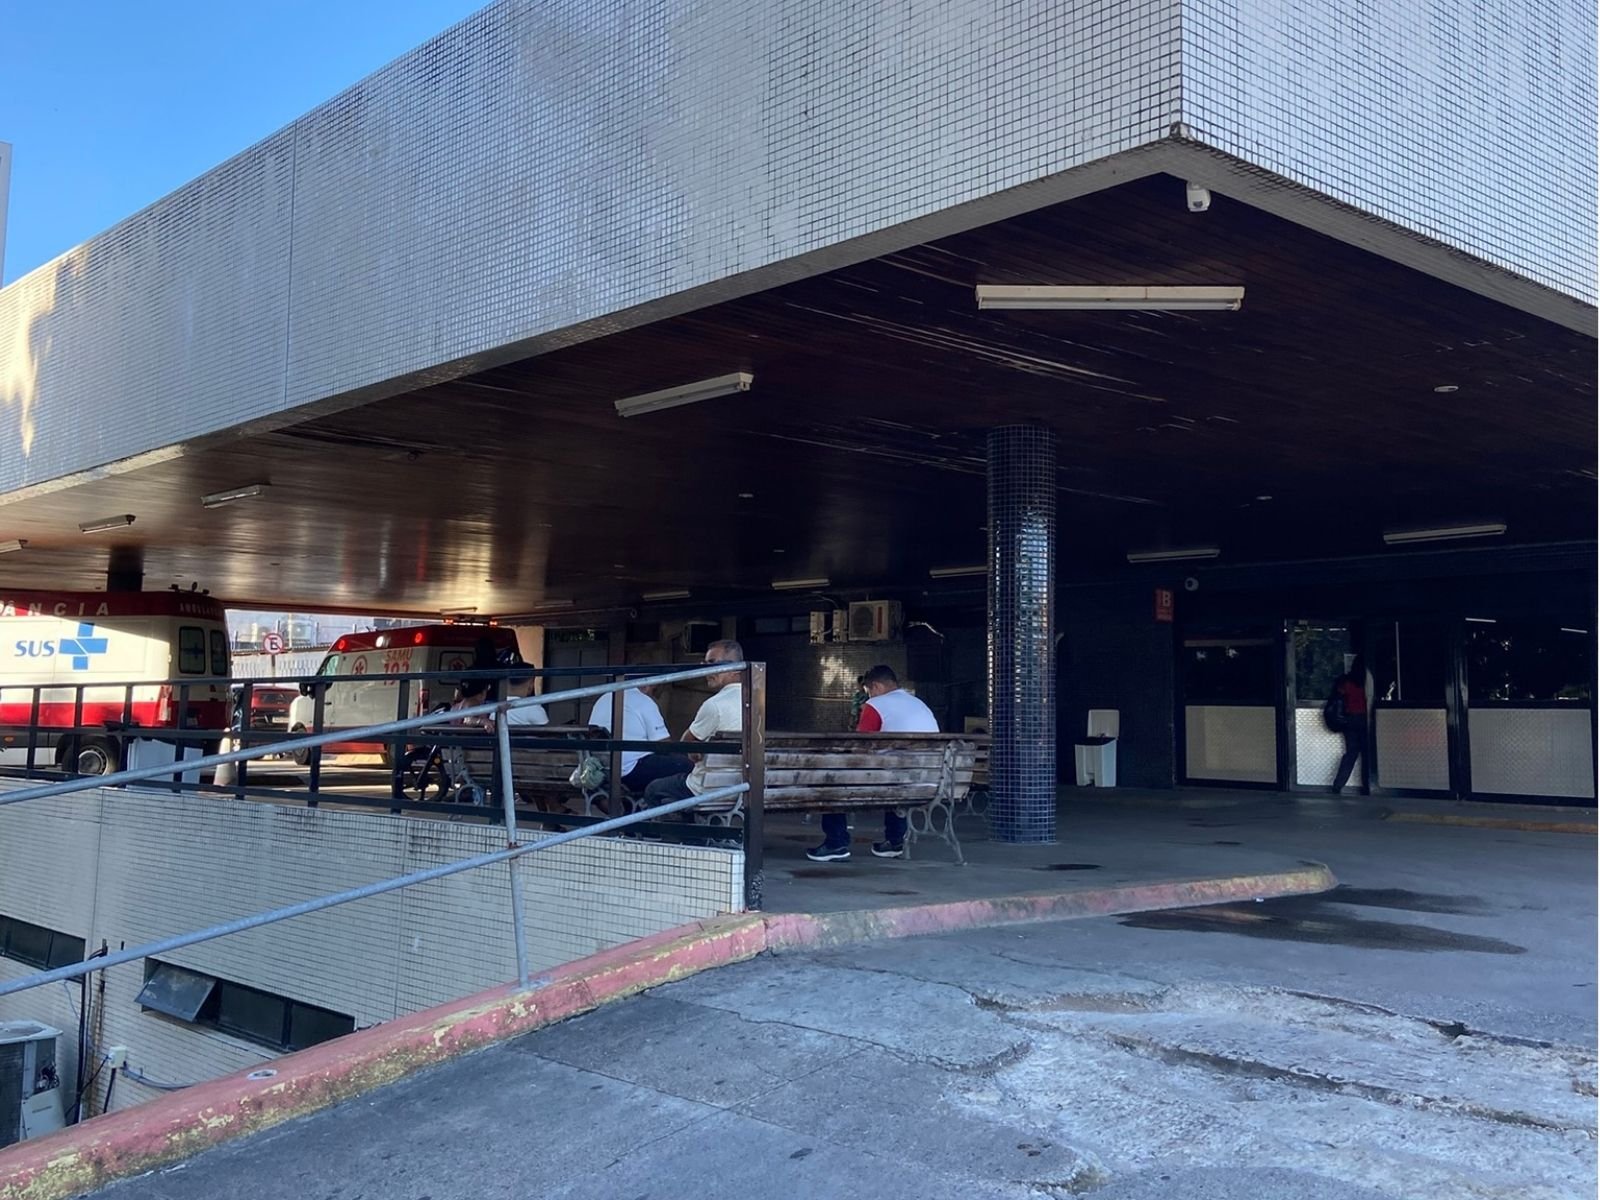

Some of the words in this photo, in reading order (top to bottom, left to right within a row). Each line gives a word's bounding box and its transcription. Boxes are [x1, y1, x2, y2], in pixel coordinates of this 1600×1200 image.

[1162, 590, 1172, 607] B
[14, 640, 55, 657] SUS
[386, 648, 413, 662] SAMU
